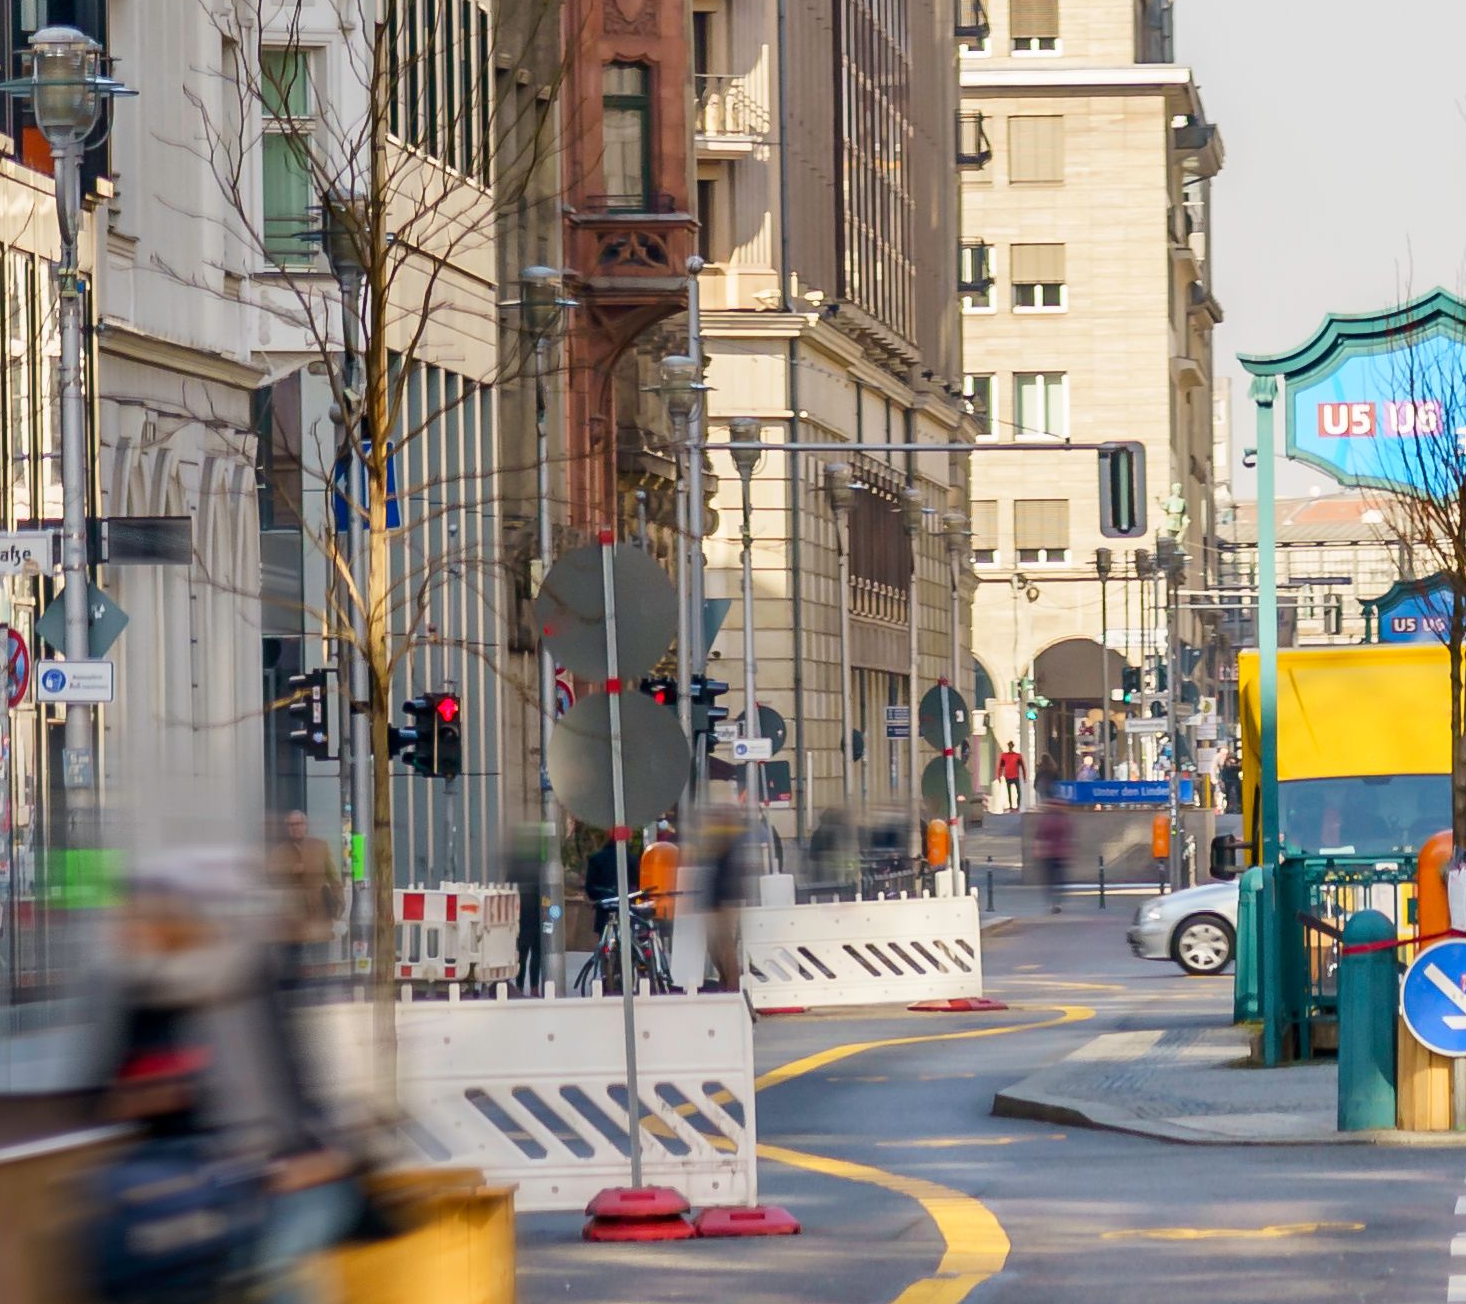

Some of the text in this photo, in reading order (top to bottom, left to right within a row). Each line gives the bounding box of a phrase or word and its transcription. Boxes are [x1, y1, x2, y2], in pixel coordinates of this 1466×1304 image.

[1323, 403, 1436, 435] U5 U6
[1394, 619, 1416, 632] U5
